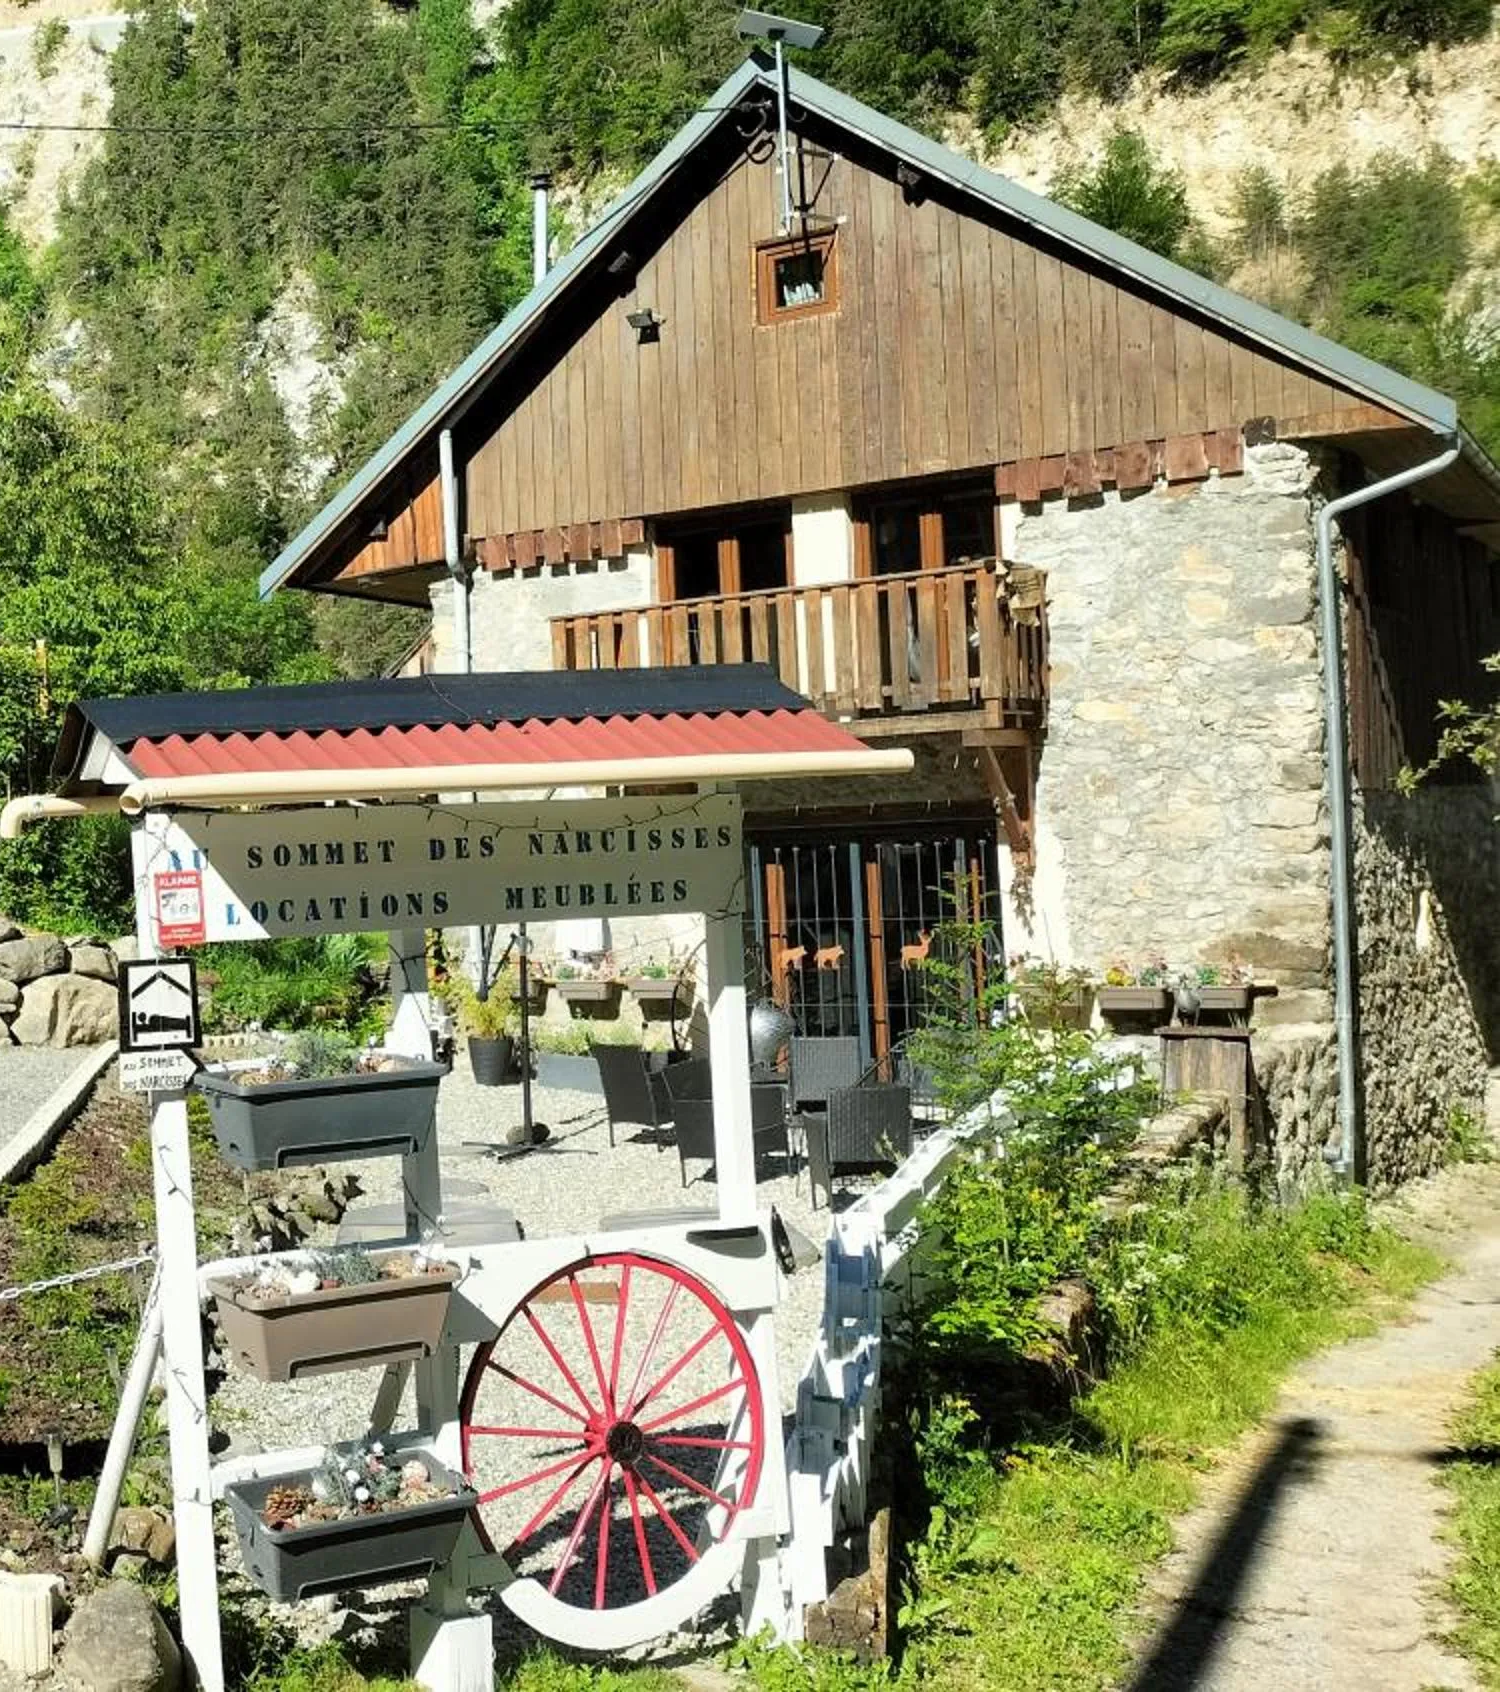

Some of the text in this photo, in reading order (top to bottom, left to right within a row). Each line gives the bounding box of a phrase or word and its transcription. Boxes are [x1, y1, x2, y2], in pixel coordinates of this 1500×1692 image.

[246, 838, 396, 869] SOMMET
[428, 834, 496, 862] DES
[527, 825, 732, 856] NARCISSES
[504, 871, 688, 910] MEUBLÉES
